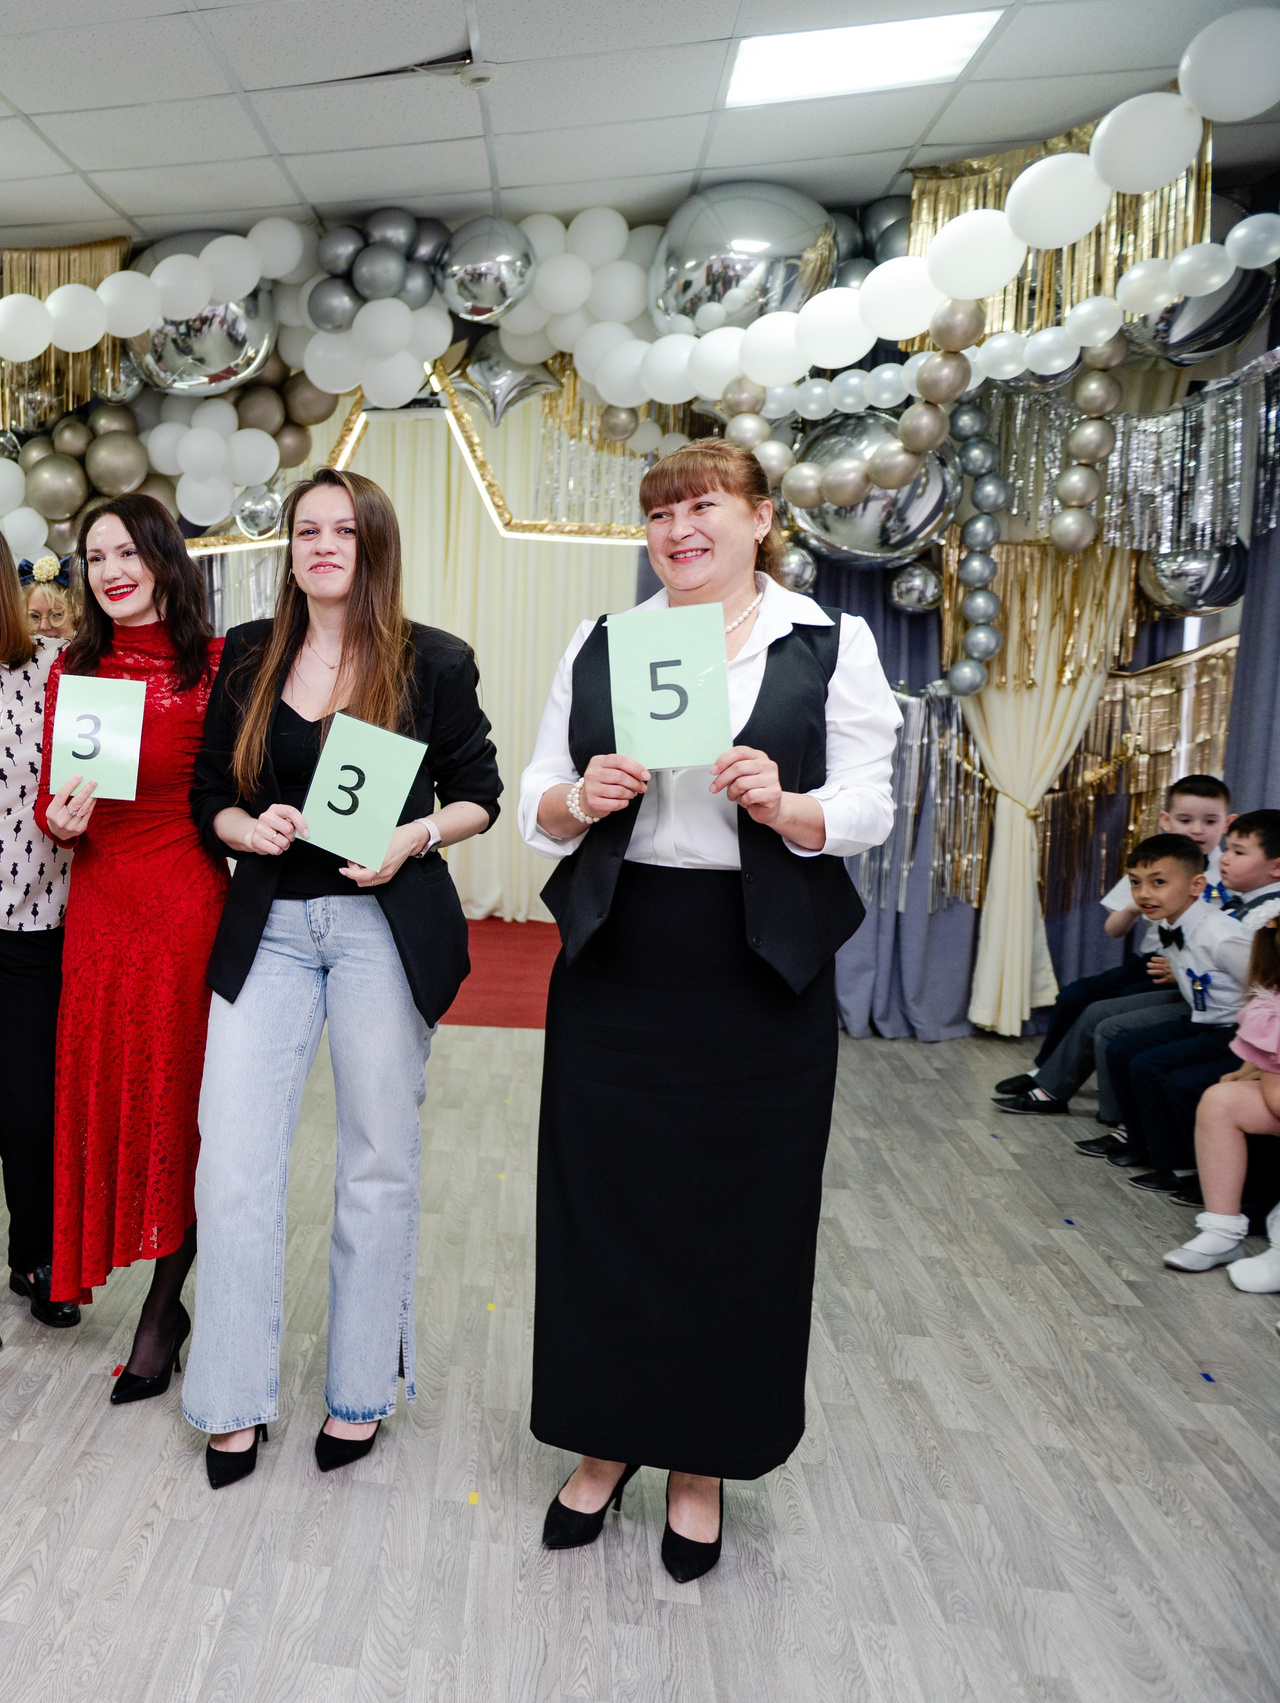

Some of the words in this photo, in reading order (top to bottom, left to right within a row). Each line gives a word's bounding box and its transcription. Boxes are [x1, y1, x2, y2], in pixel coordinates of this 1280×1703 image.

[649, 658, 689, 721] 5
[71, 714, 102, 760] 3
[326, 764, 367, 817] 3
